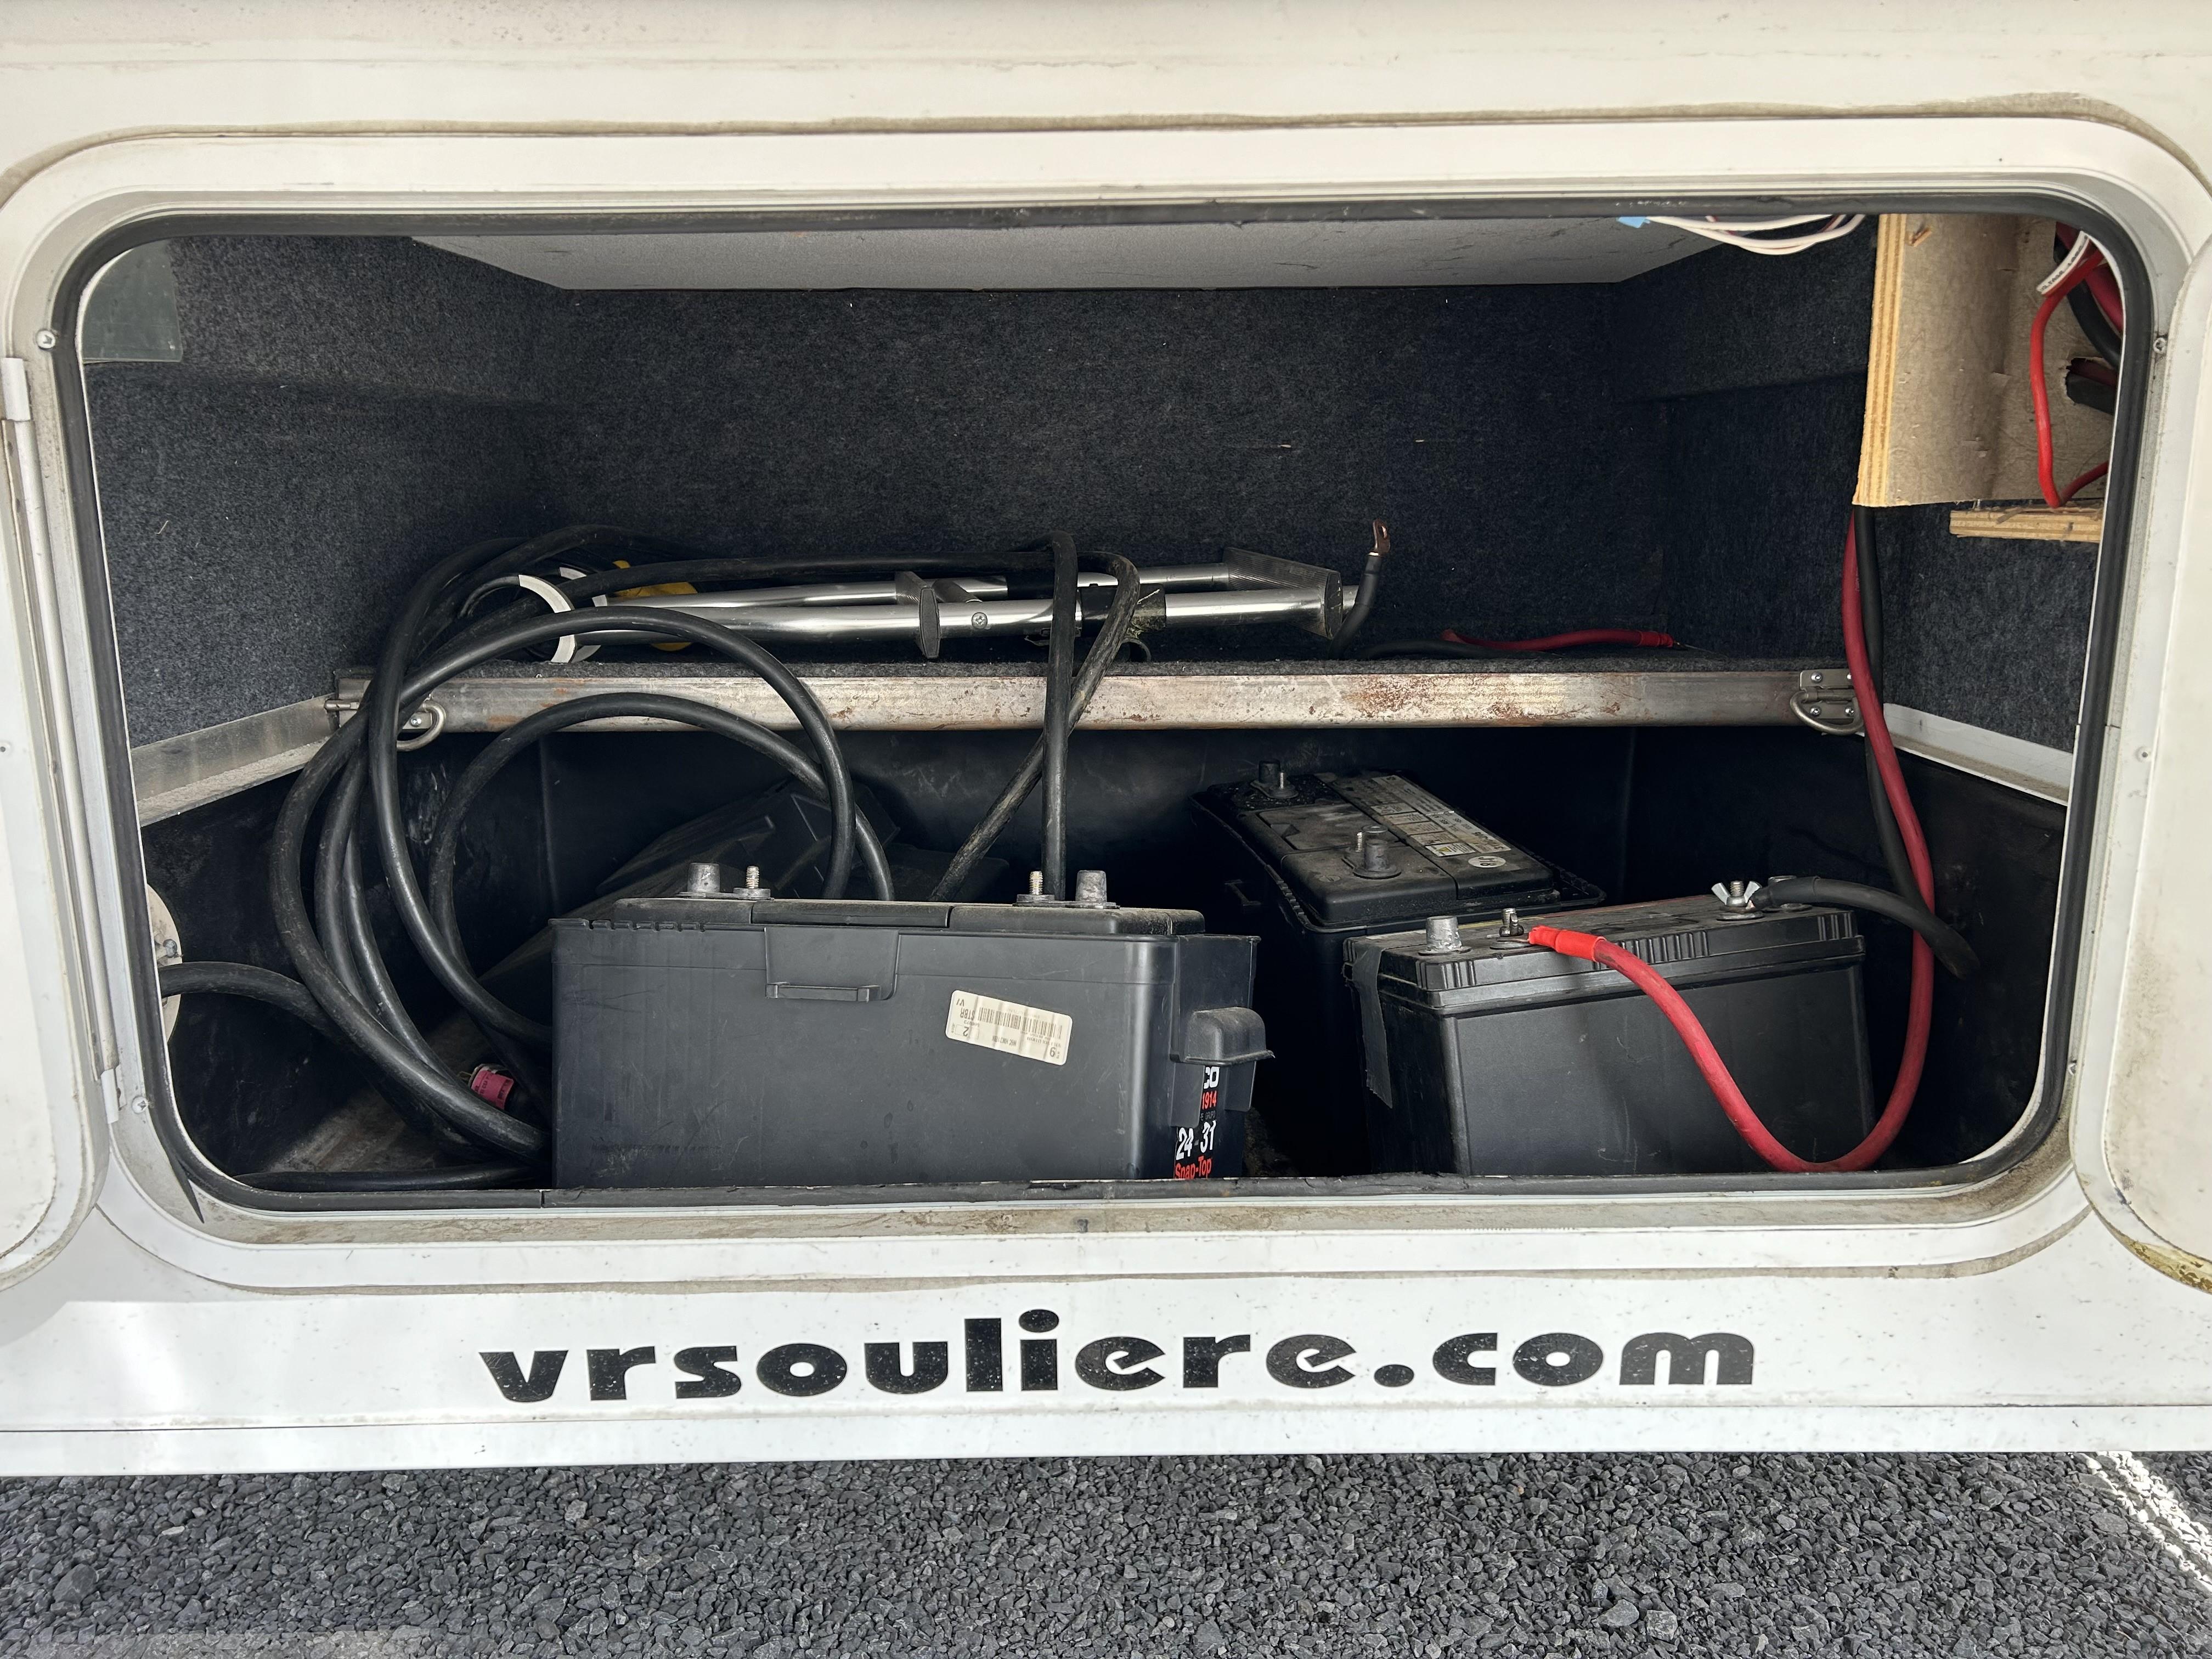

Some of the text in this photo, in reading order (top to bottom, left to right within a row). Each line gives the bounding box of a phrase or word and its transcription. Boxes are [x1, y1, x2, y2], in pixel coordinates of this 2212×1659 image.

[1478, 857, 1497, 866] J18
[1202, 1090, 1217, 1110] 1914
[1175, 1155, 1212, 1180] Snap-Top
[478, 1308, 1755, 1403] vrsouliere.com
